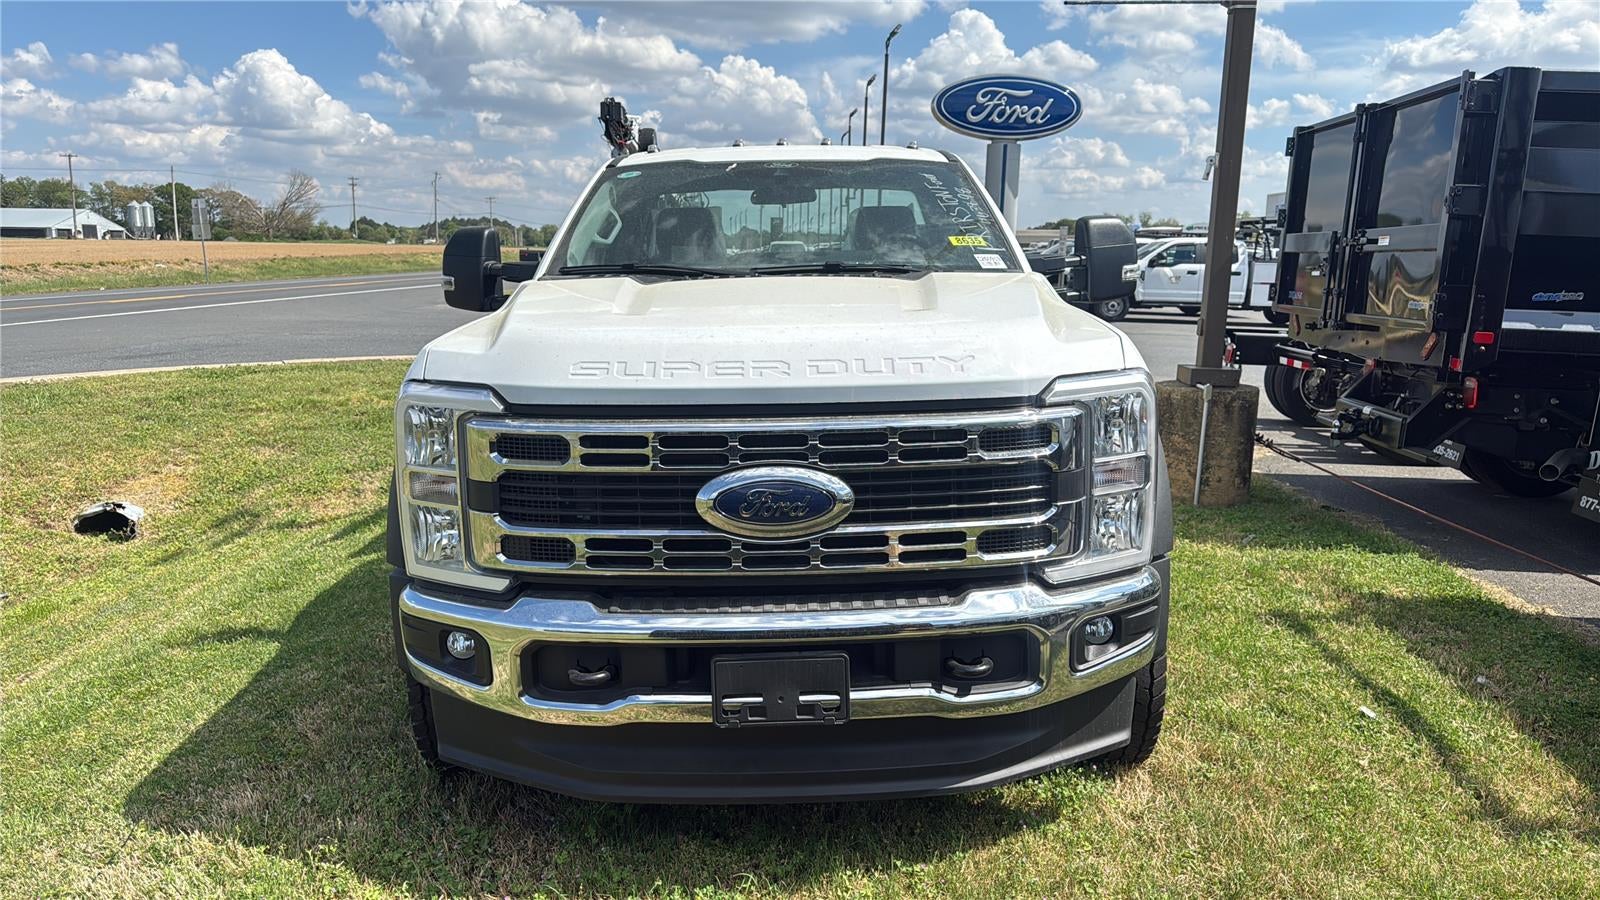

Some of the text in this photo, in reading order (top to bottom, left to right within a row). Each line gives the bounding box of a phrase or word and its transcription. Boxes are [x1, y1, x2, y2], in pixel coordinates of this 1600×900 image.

[966, 87, 1054, 125] Ford
[568, 354, 977, 380] SUPER DUTY
[738, 488, 812, 518] Ford
